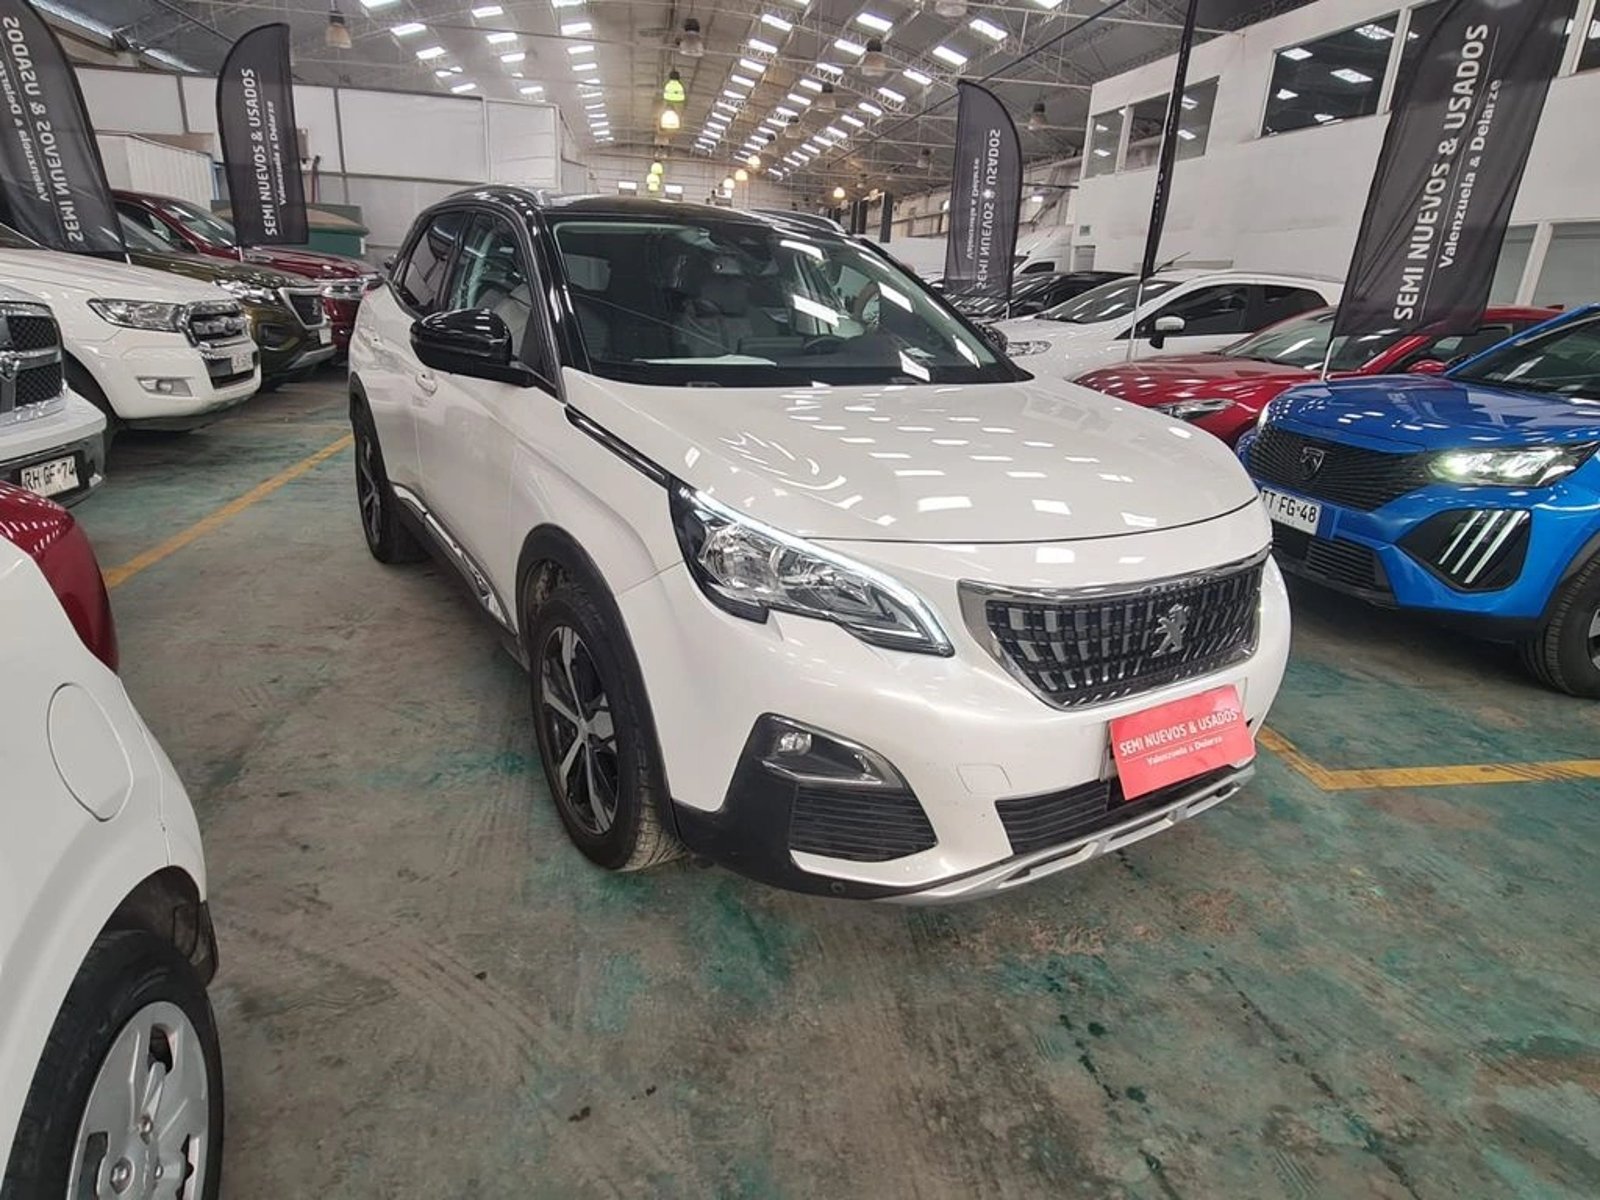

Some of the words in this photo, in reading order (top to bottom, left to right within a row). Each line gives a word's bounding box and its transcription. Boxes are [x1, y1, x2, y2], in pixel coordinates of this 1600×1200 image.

[241, 68, 261, 127] USADOS
[1444, 24, 1488, 130] USADOS
[253, 145, 272, 201] NUEVOS
[1438, 137, 1458, 155] &
[1439, 172, 1476, 269] Valenzuela
[1471, 79, 1501, 151] Delarze
[262, 203, 278, 236] SEMI
[1408, 163, 1450, 260] NUEVOS
[1394, 266, 1425, 320] SEMI
[1119, 739, 1144, 756] SEMI
[1144, 723, 1187, 747] NUEVOS
[1198, 710, 1238, 731] USADOS
